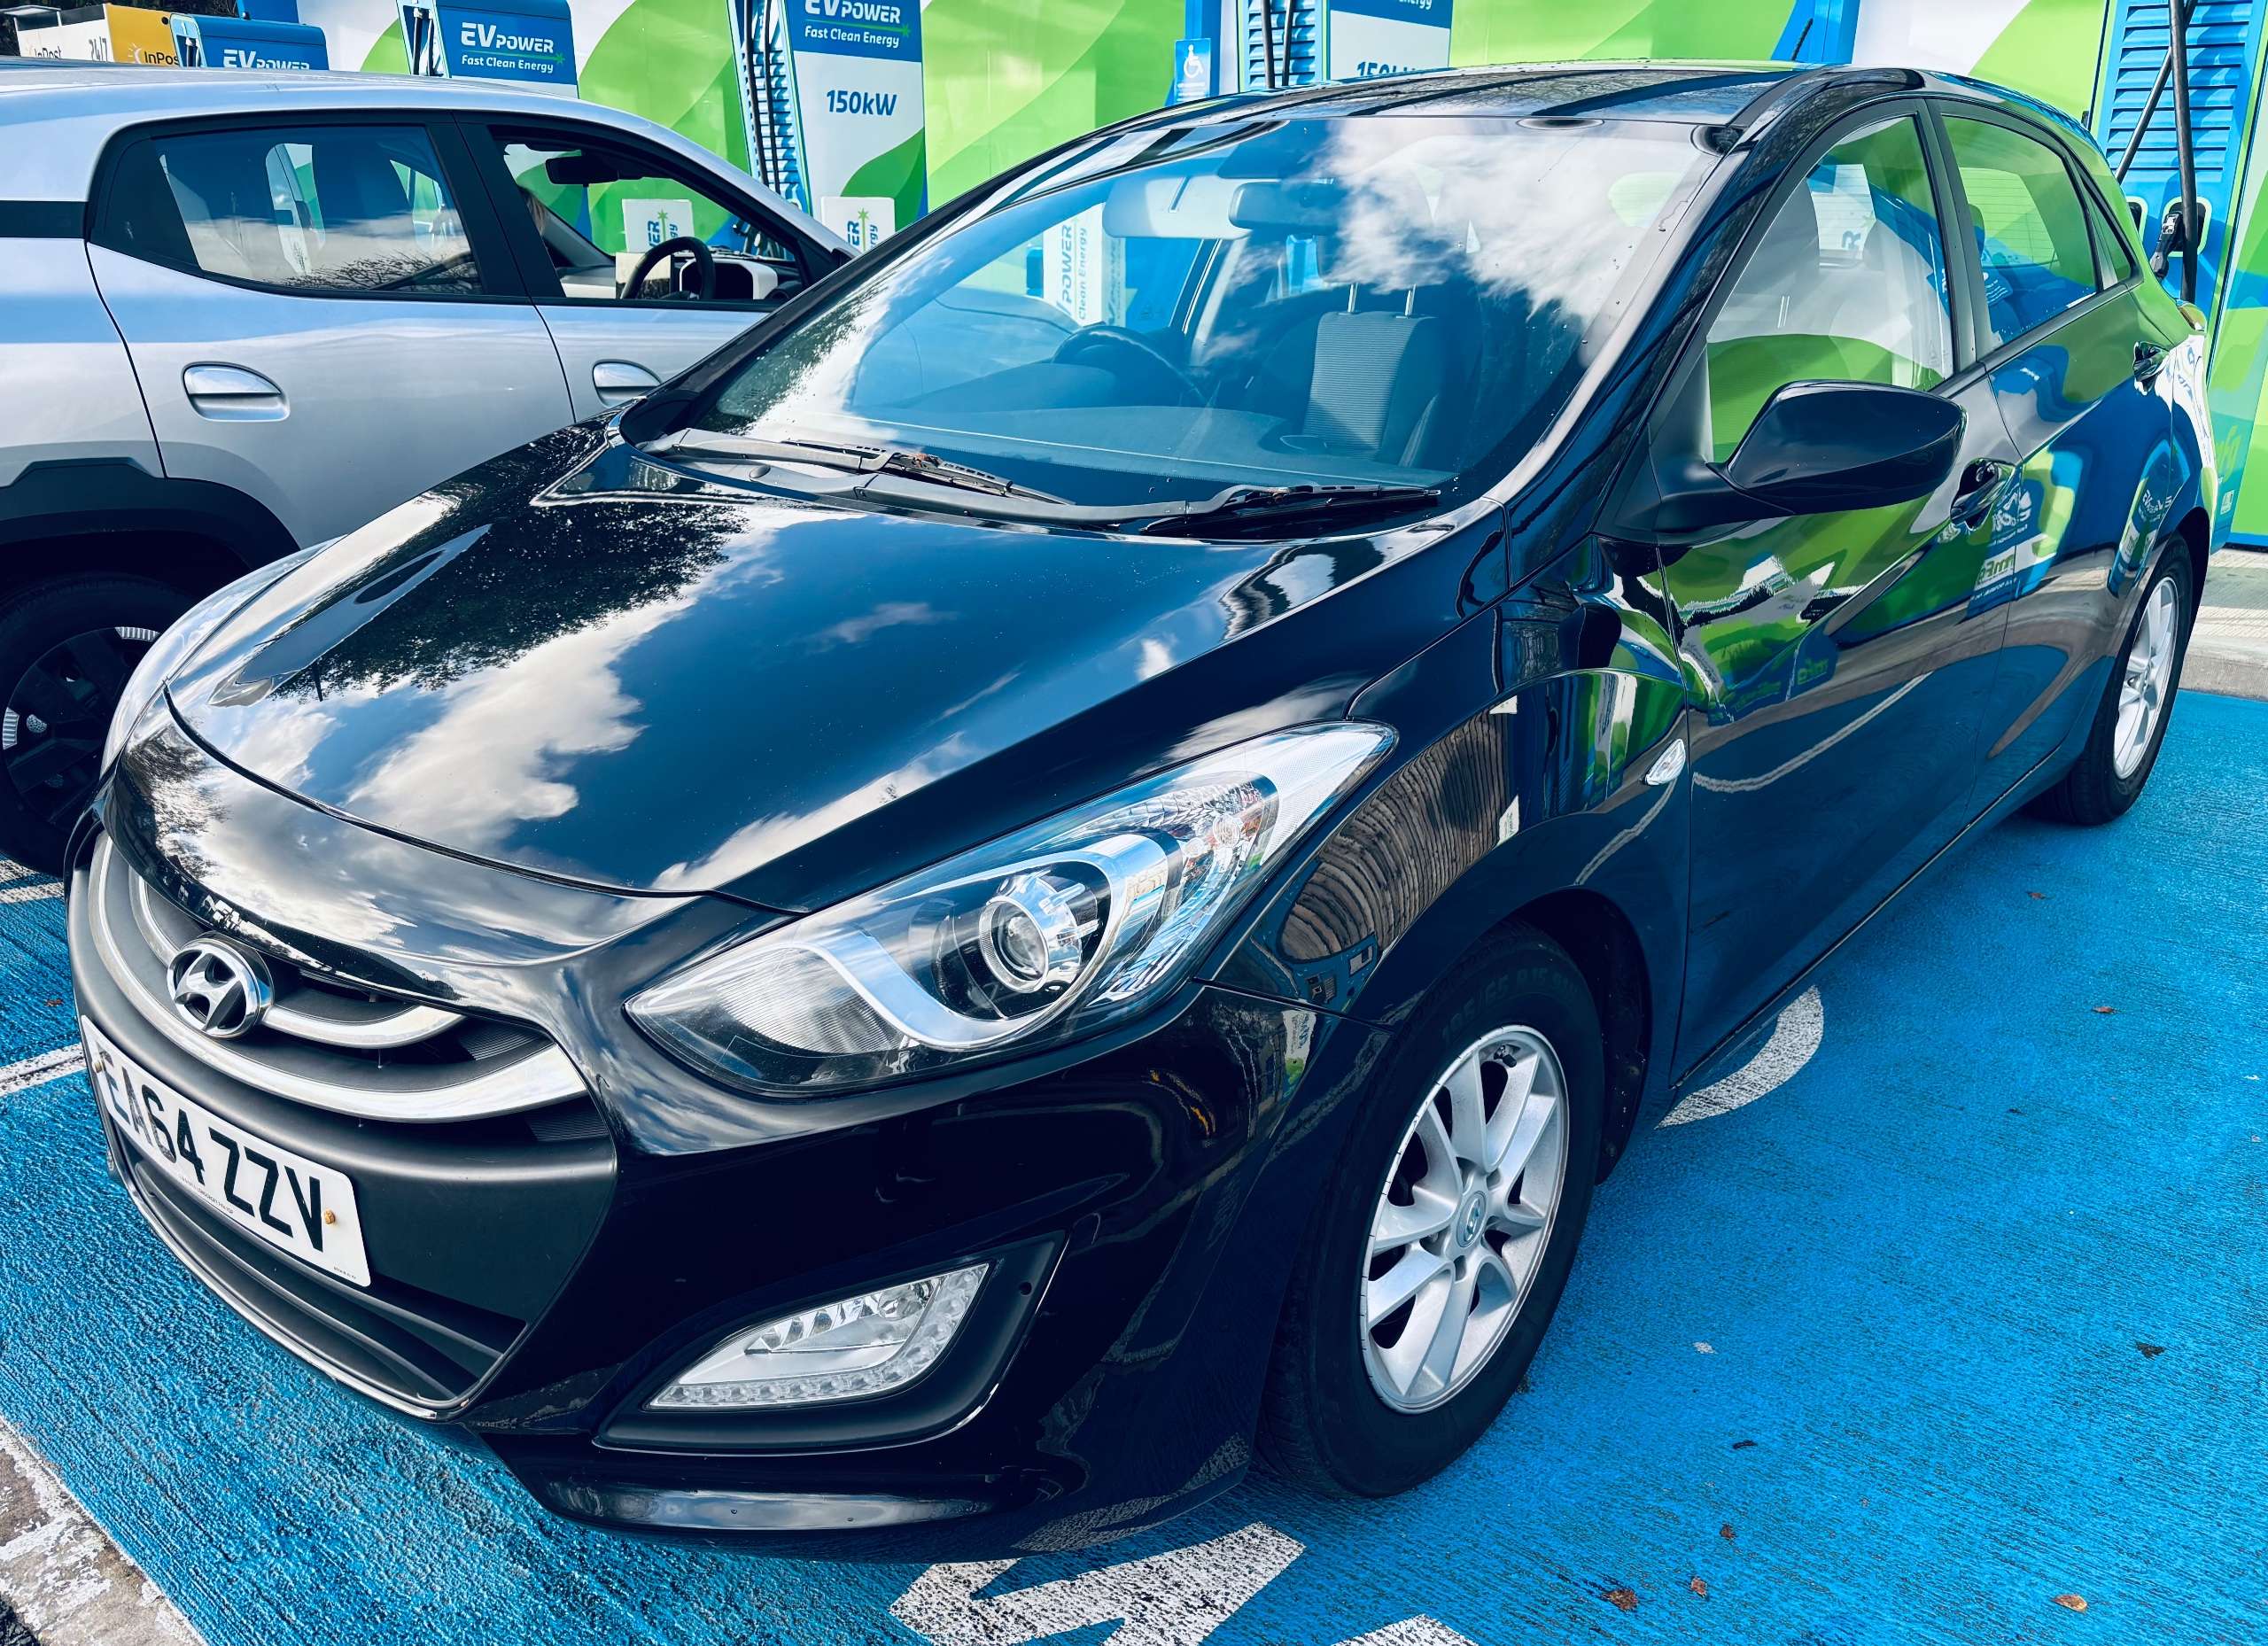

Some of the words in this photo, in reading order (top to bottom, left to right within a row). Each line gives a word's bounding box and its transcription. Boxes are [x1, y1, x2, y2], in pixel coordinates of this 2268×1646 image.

[804, 25, 828, 38] Fast
[830, 28, 861, 43] Clean
[863, 32, 900, 49] Energy
[462, 54, 485, 66] Fast
[485, 57, 516, 69] Clean
[517, 59, 554, 74] Energy
[827, 89, 897, 116] 150kW
[208, 1126, 323, 1253] ZZV
